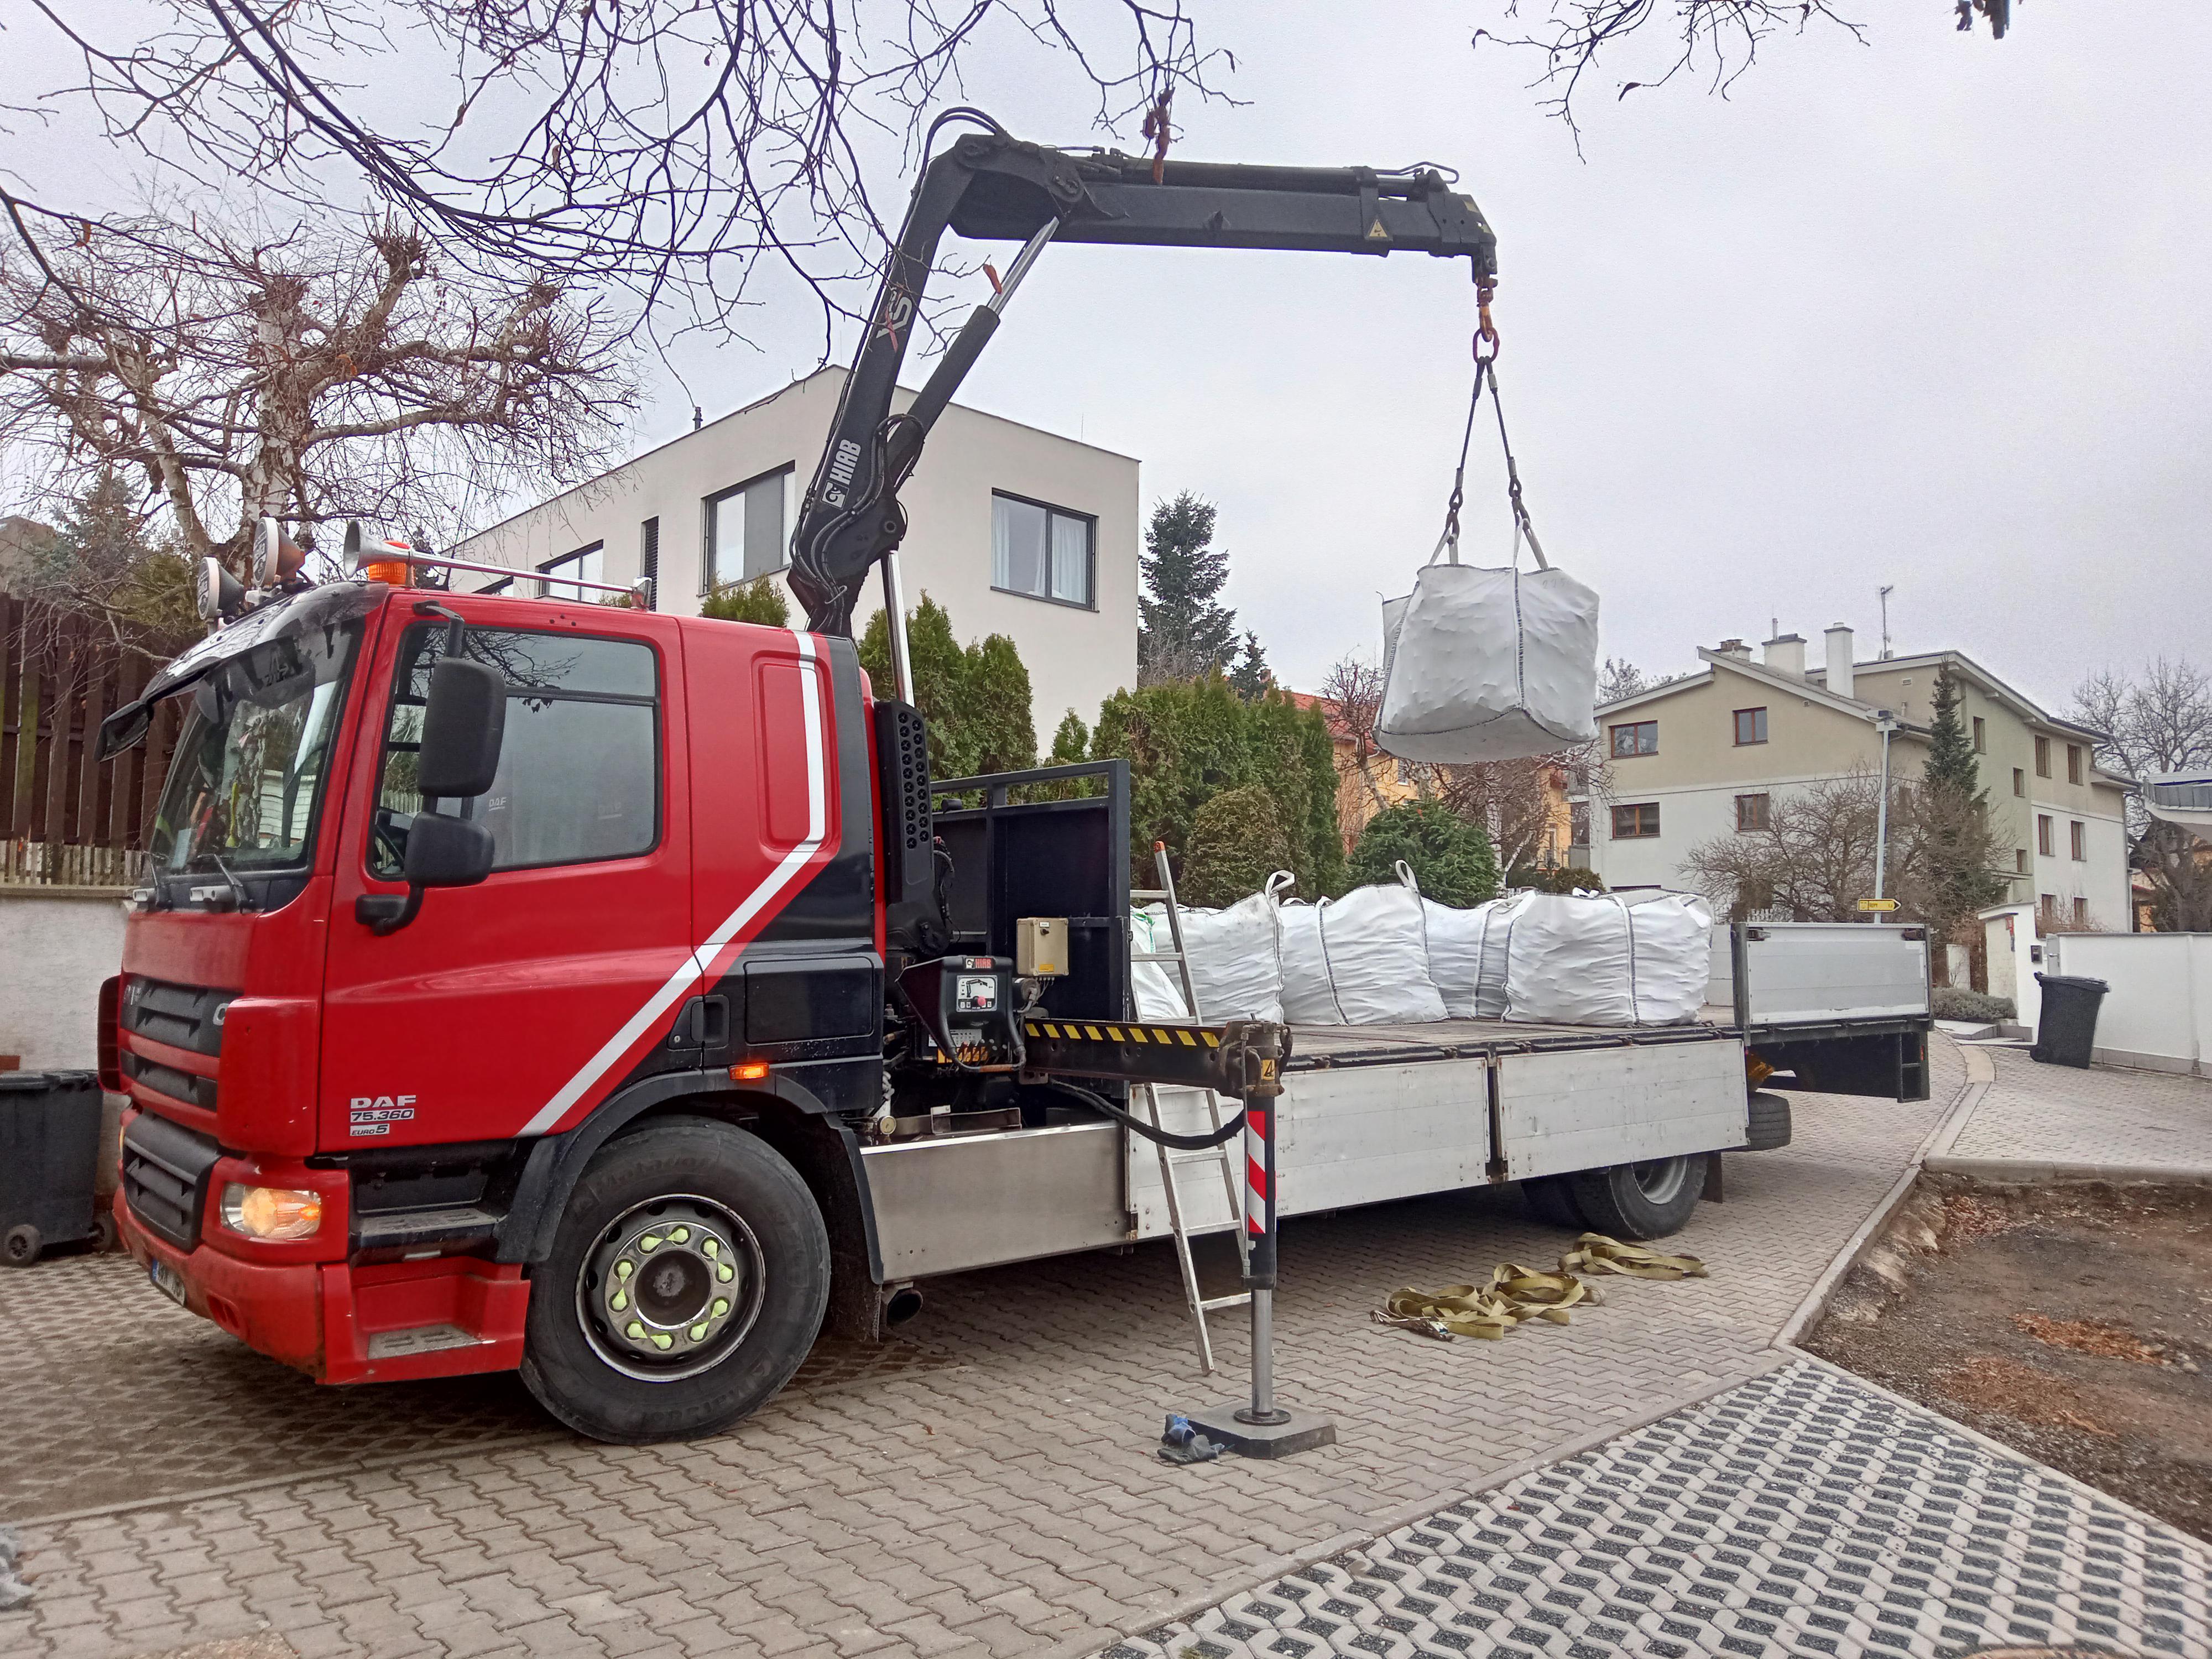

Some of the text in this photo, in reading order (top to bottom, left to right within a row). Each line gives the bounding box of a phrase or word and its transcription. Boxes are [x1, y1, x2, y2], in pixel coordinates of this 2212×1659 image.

[830, 439, 861, 486] HIAB
[489, 797, 507, 807] DAF
[975, 958, 992, 969] HIAB
[351, 1095, 416, 1109] DAF
[352, 1109, 414, 1121] 75.360
